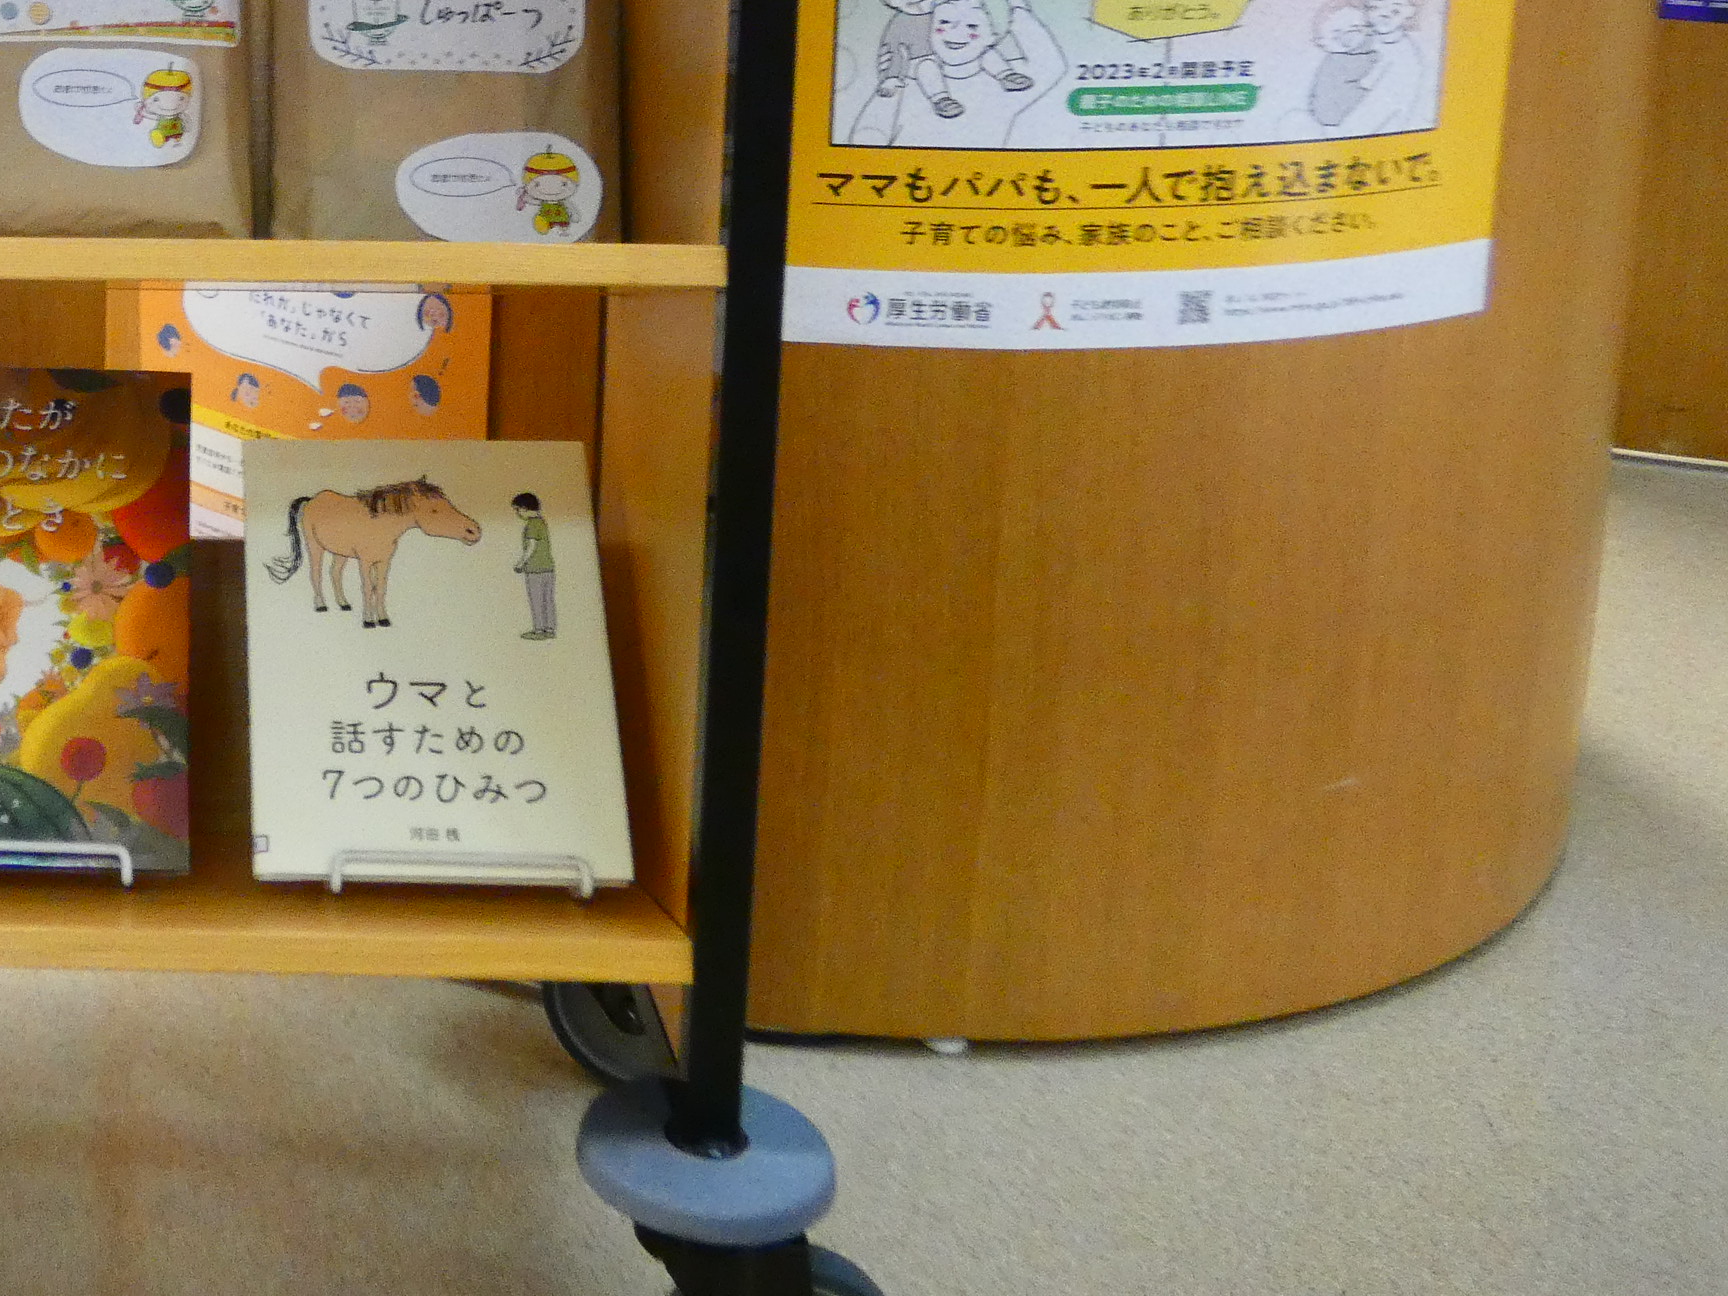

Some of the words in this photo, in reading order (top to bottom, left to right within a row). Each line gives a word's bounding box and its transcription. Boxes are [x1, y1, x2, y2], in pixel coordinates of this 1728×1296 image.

[816, 151, 1440, 205] ママもパパも、一人で抱え込まないで。
[887, 297, 991, 322] 厚生労働省
[365, 671, 487, 710] ウマと
[329, 720, 525, 756] 話すための
[321, 769, 548, 805] 7つのひみつ
